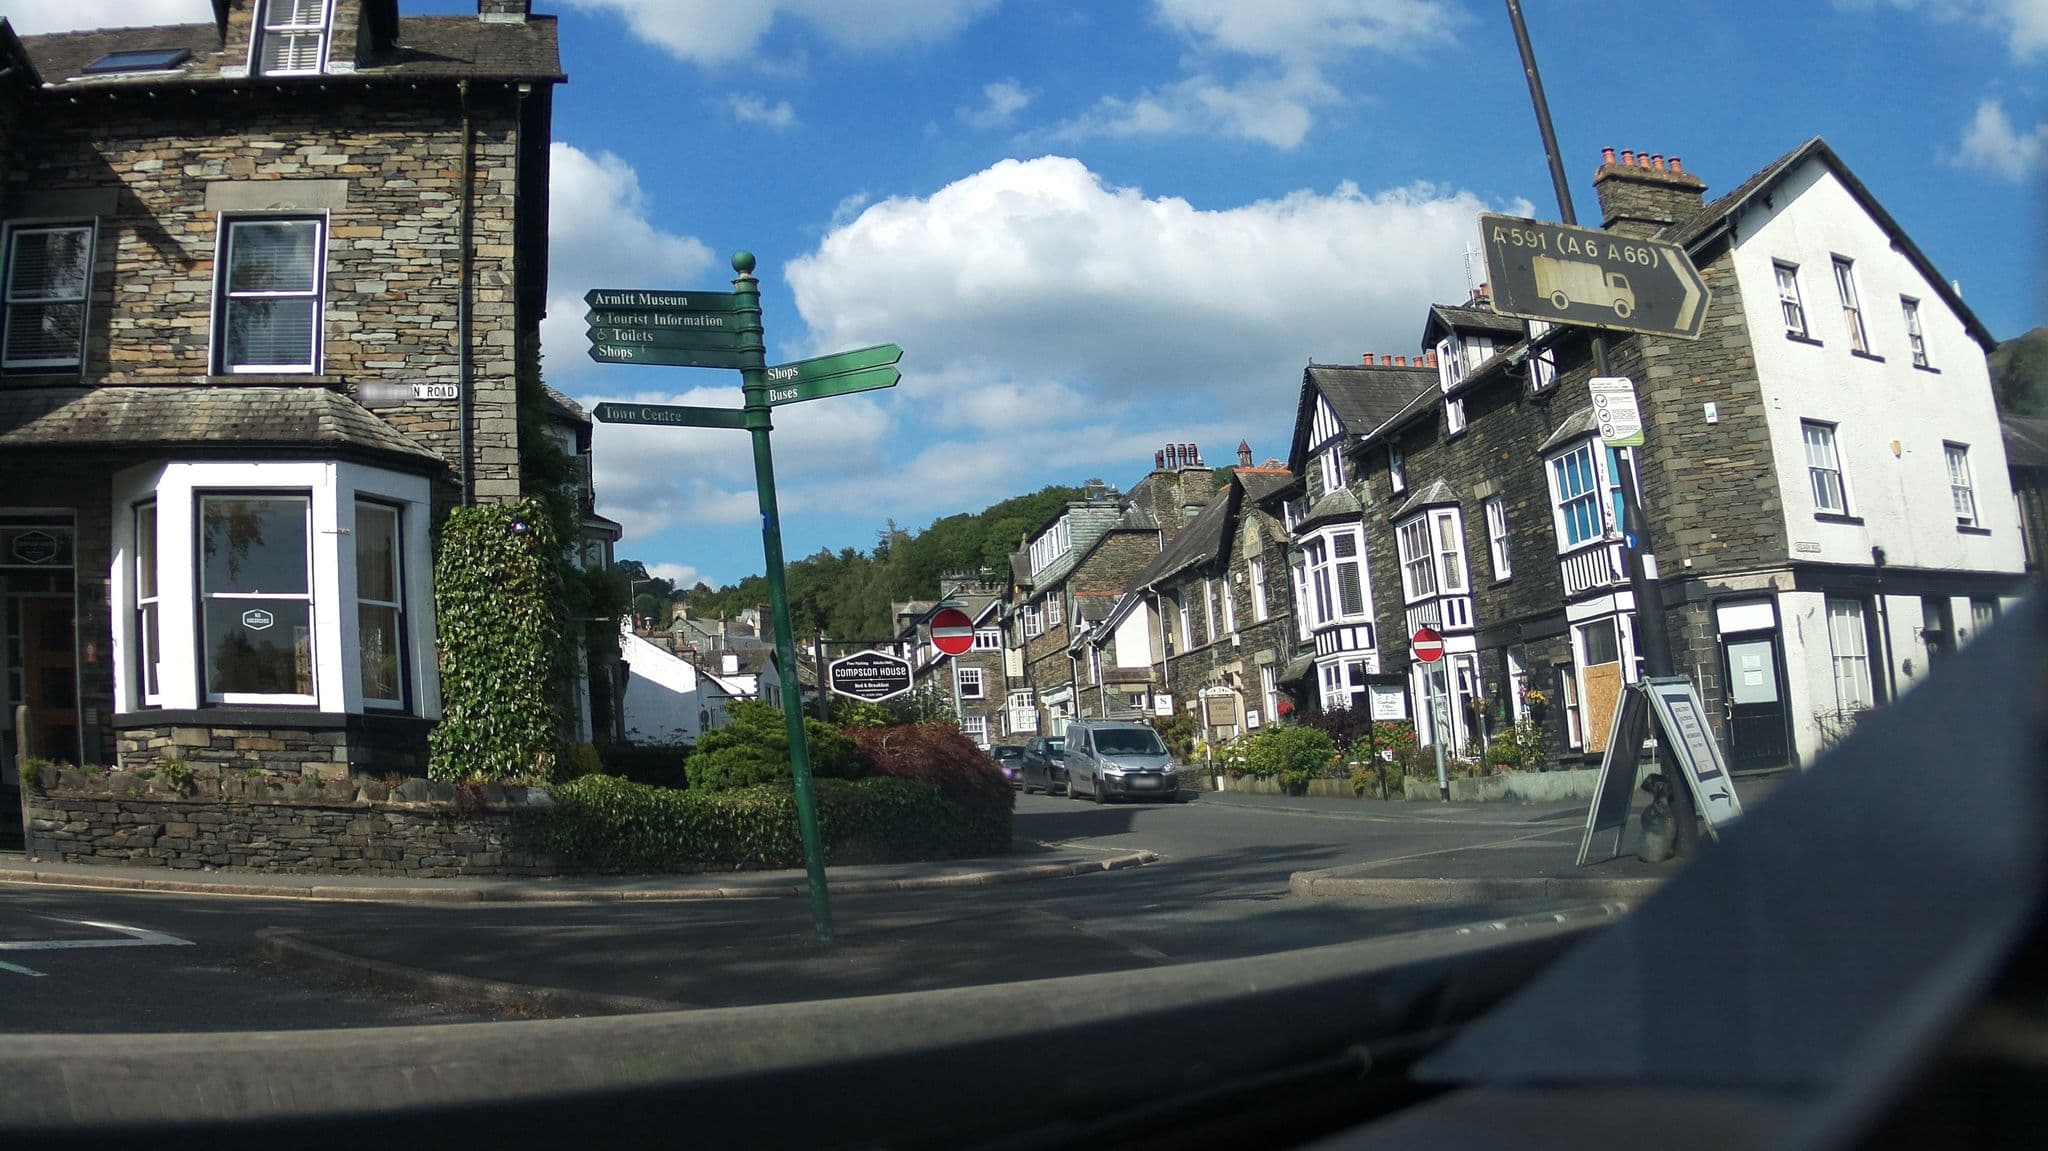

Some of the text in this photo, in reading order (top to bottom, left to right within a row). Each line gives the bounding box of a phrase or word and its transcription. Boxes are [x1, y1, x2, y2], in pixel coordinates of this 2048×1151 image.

[595, 293, 688, 306] Armitt Museum
[607, 313, 648, 325] Tourist
[654, 313, 723, 326] Information
[612, 328, 654, 342] Toilets
[598, 345, 633, 360] Shops
[767, 367, 798, 380] Shops
[427, 386, 454, 397] ROAD
[769, 388, 798, 402] Buses
[605, 406, 682, 422] Town Centre
